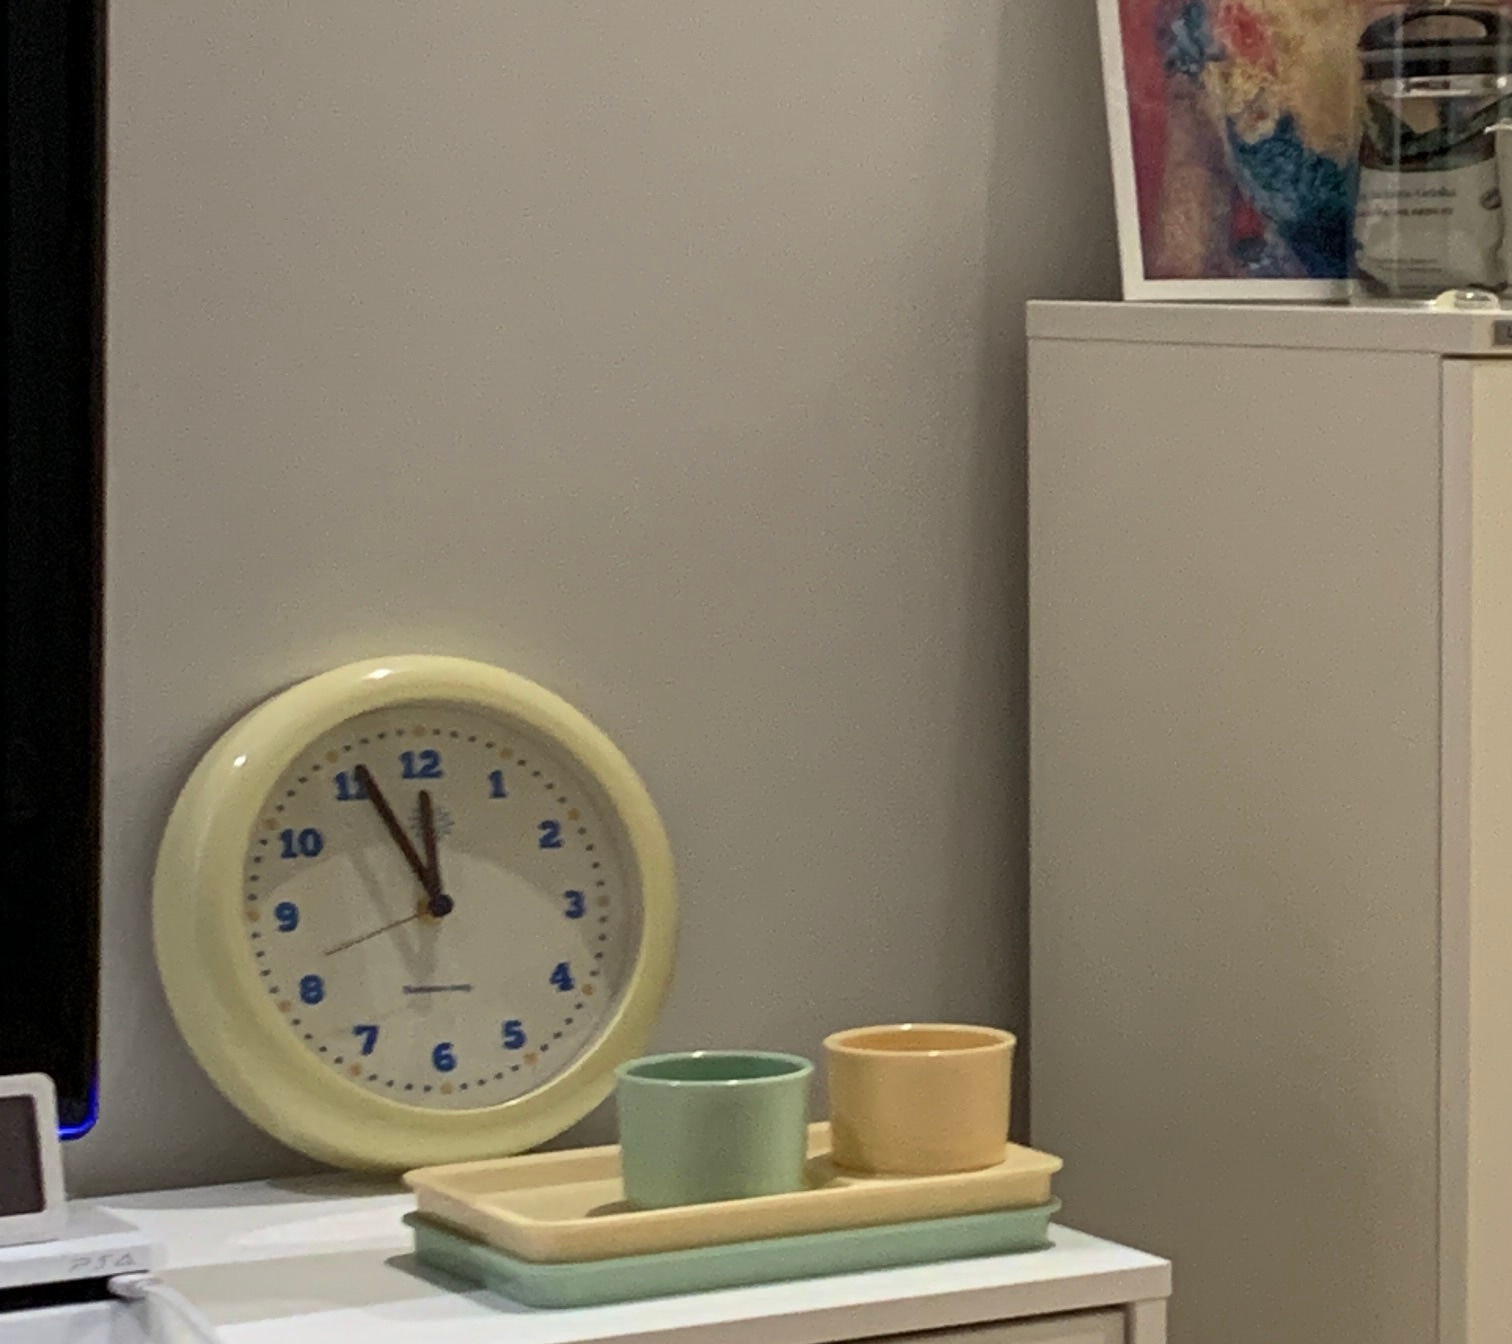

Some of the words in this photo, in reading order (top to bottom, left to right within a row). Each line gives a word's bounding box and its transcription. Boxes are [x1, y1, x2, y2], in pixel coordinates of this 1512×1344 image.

[401, 749, 443, 779] 12
[487, 769, 508, 799] 1
[280, 828, 325, 859] 10
[538, 820, 564, 849] 2
[275, 901, 300, 933] 9
[564, 890, 587, 919] 3
[300, 974, 326, 1006] 8
[549, 962, 575, 992] 4
[353, 1024, 380, 1056] 7
[503, 1020, 528, 1050] 5
[432, 1042, 458, 1073] 6
